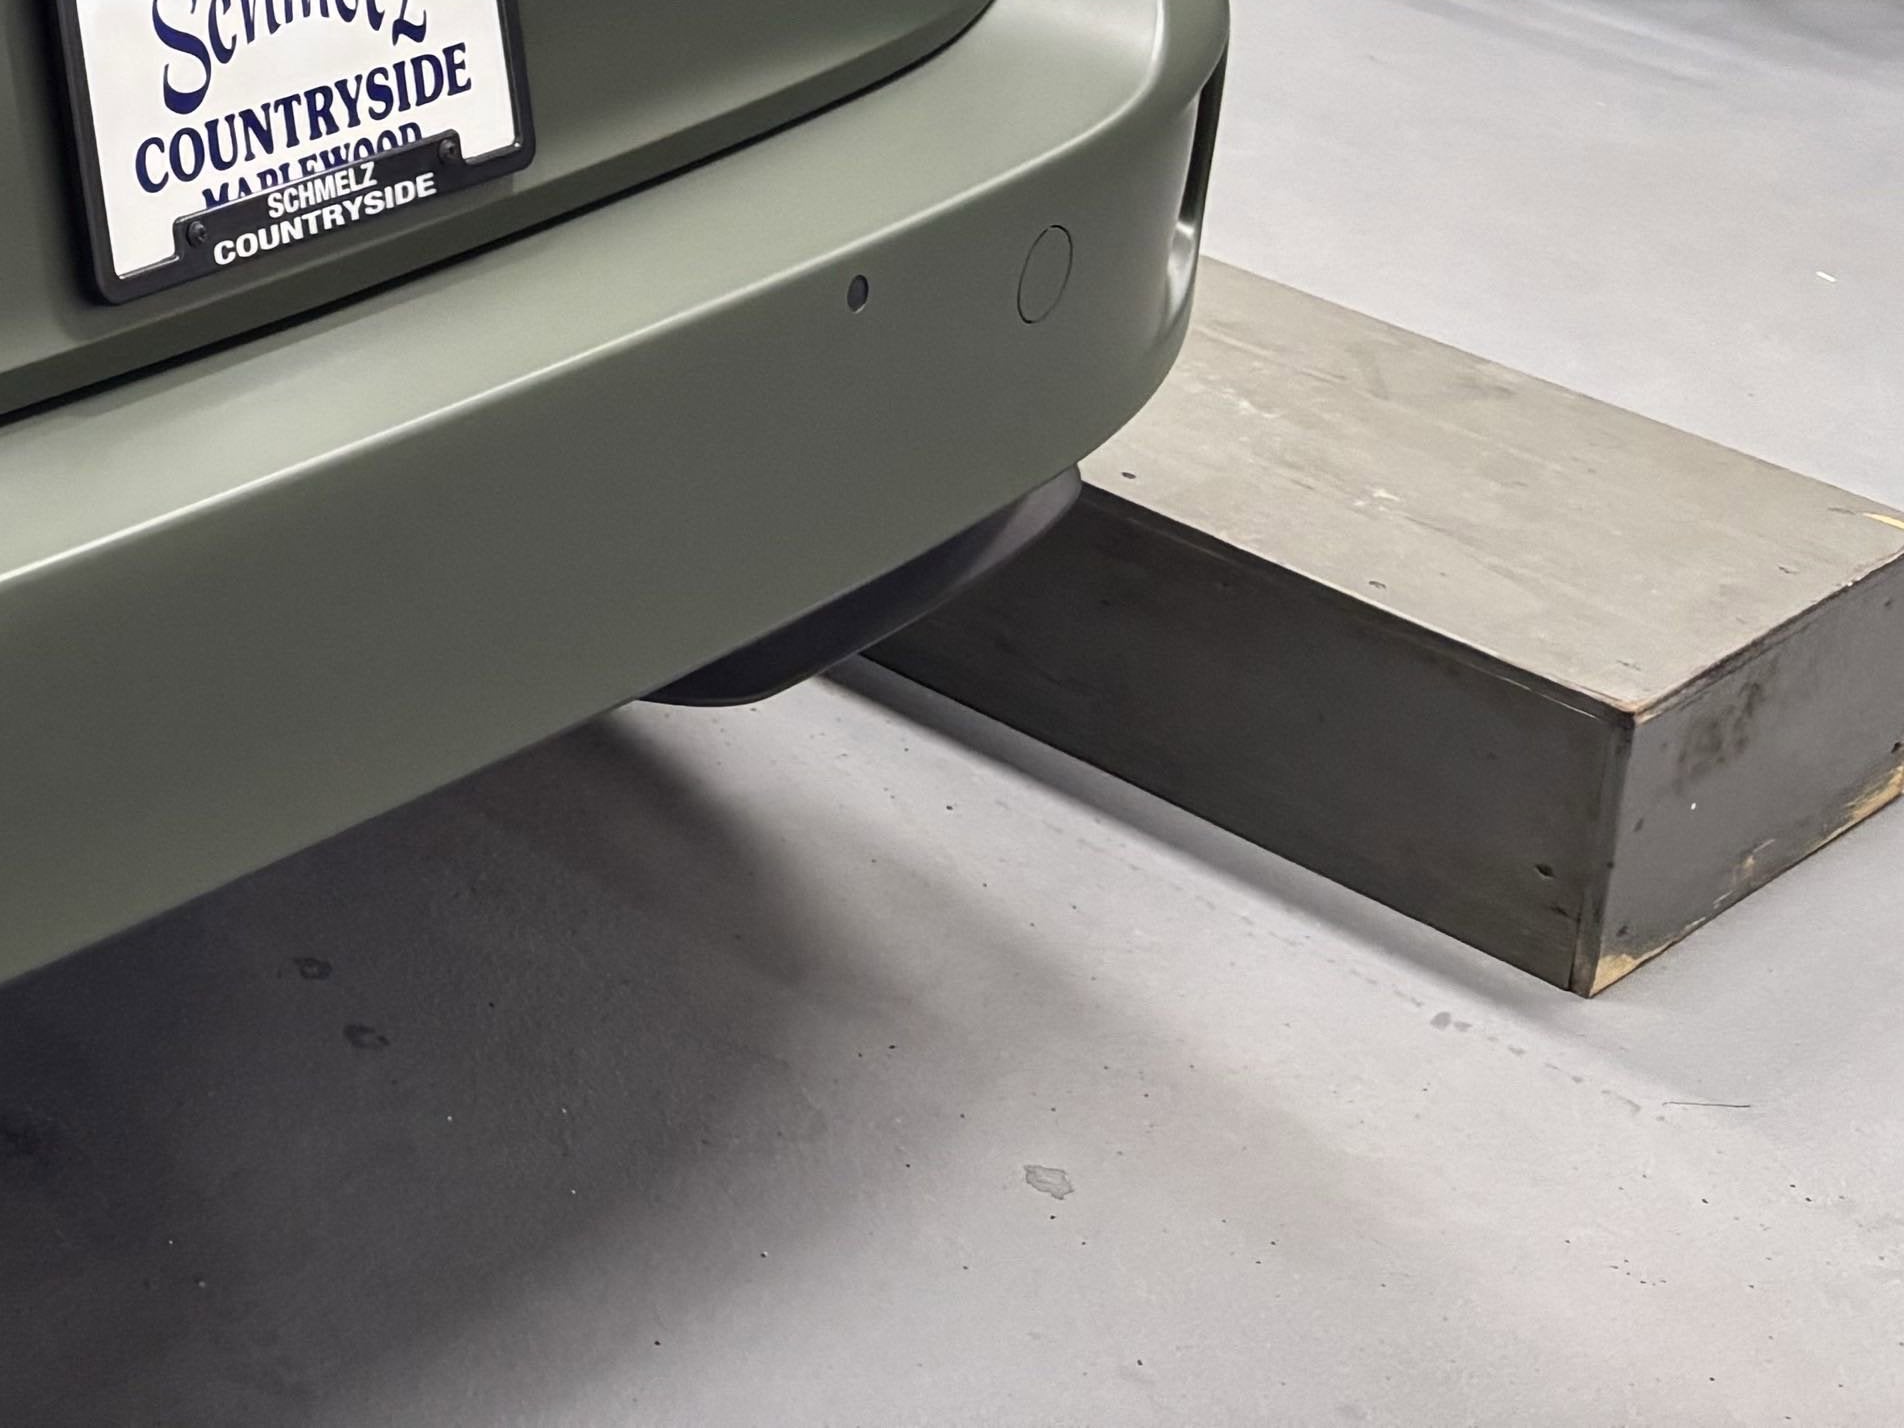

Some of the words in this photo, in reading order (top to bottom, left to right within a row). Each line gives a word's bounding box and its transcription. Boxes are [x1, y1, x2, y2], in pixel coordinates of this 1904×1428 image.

[135, 42, 472, 193] COUNTRYSIDE
[213, 171, 437, 266] COUNTRYSIDE
[267, 160, 378, 219] SCHMELZ
